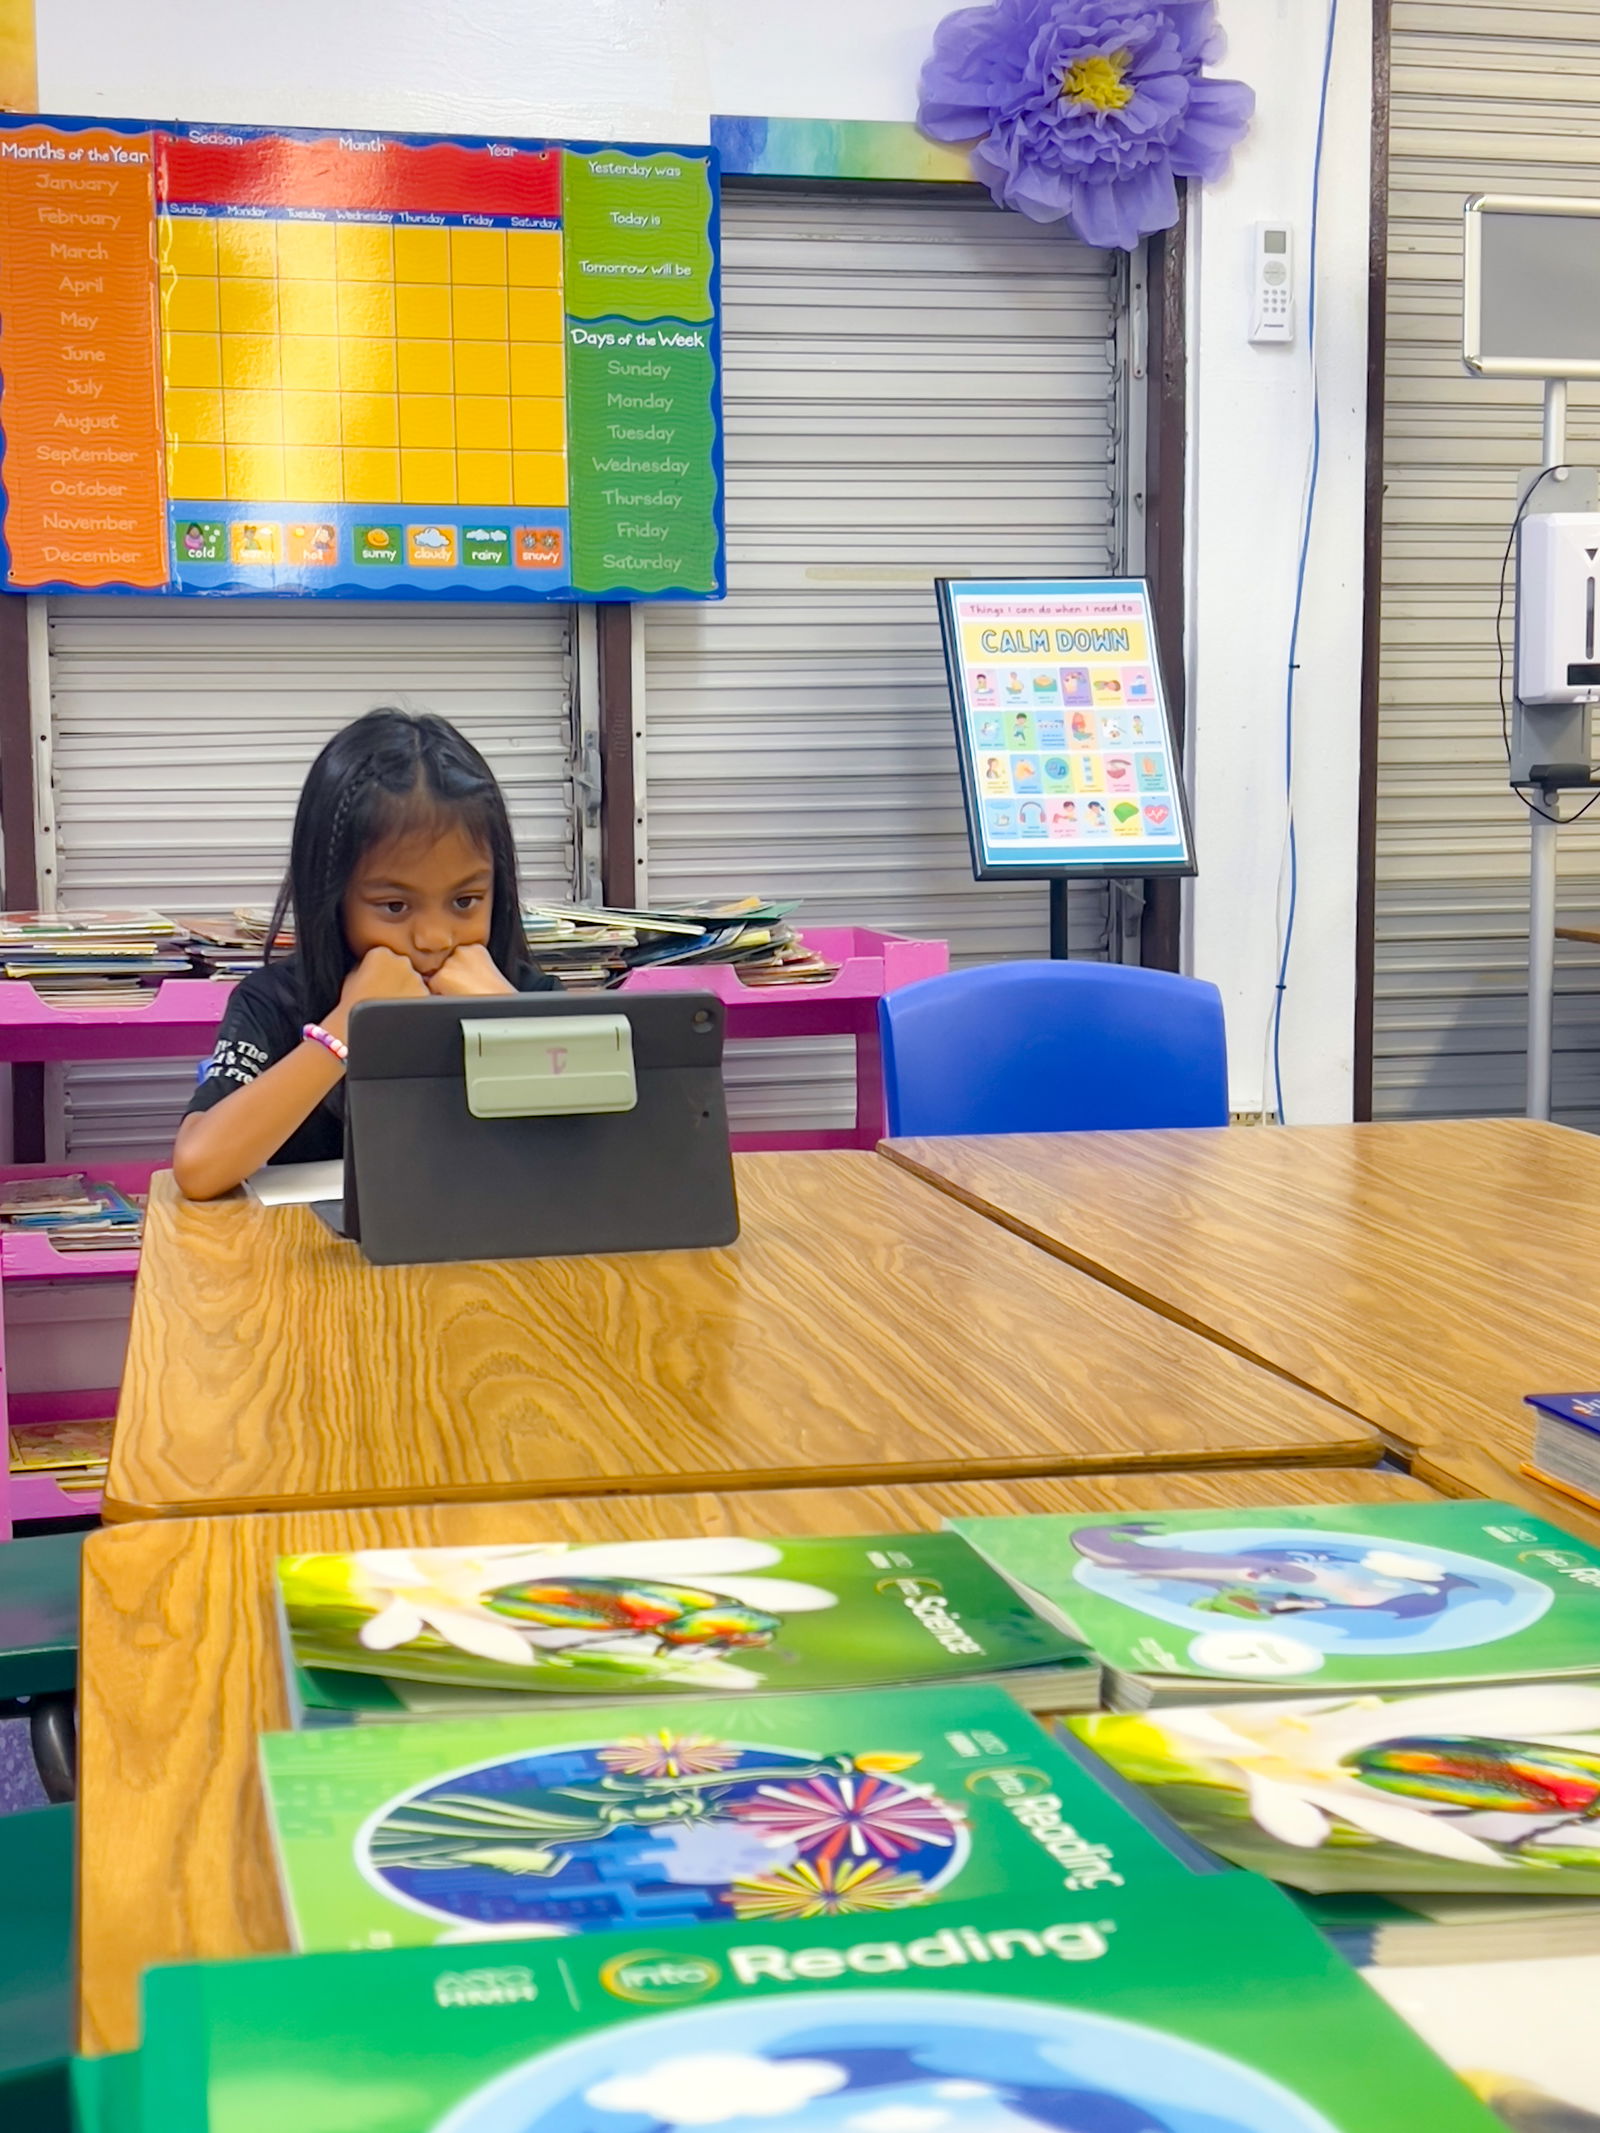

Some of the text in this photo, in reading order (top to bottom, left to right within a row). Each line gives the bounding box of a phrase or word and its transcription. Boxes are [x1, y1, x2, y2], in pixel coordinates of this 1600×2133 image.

[188, 130, 243, 146] Season
[339, 137, 386, 152] Month
[1, 143, 150, 164] Months of the Year
[486, 143, 519, 158] Year
[588, 161, 681, 177] Yesterday was
[35, 174, 120, 196] January
[169, 203, 208, 217] Sunday
[227, 205, 268, 219] Monday
[286, 208, 327, 221] Tuesday
[336, 210, 393, 224] Wednesday
[37, 208, 121, 231] February
[399, 213, 446, 225] Thursday
[462, 214, 494, 227] Friday
[511, 217, 558, 230] Saturday
[610, 211, 661, 227] Today is
[50, 243, 109, 260] March
[579, 260, 692, 276] Tomorrow will be
[59, 276, 103, 296] April
[60, 311, 99, 330] May
[570, 328, 705, 348] Days of the Week
[61, 346, 105, 363] June
[607, 360, 671, 381] Sunday
[66, 379, 103, 399] July
[607, 393, 674, 413] Monday
[54, 412, 120, 434] August
[606, 424, 675, 444] Tuesday
[36, 446, 139, 466] September
[591, 456, 690, 476] Wednesday
[50, 480, 128, 497] October
[601, 489, 683, 510] Thursday
[42, 514, 138, 531] November
[616, 522, 670, 541] Friday
[41, 547, 141, 565] December
[188, 546, 216, 560] cold
[362, 549, 397, 563] sunny
[414, 548, 453, 562] cloudy
[471, 549, 503, 563] rainy
[522, 551, 560, 564] snowy
[602, 554, 682, 573] Saturday
[970, 604, 1004, 617] Things
[1016, 606, 1035, 615] can
[1039, 604, 1051, 614] do
[1055, 604, 1082, 614] when
[1093, 603, 1118, 613] need
[1121, 603, 1133, 613] to
[981, 627, 1130, 654] CALM DOWN
